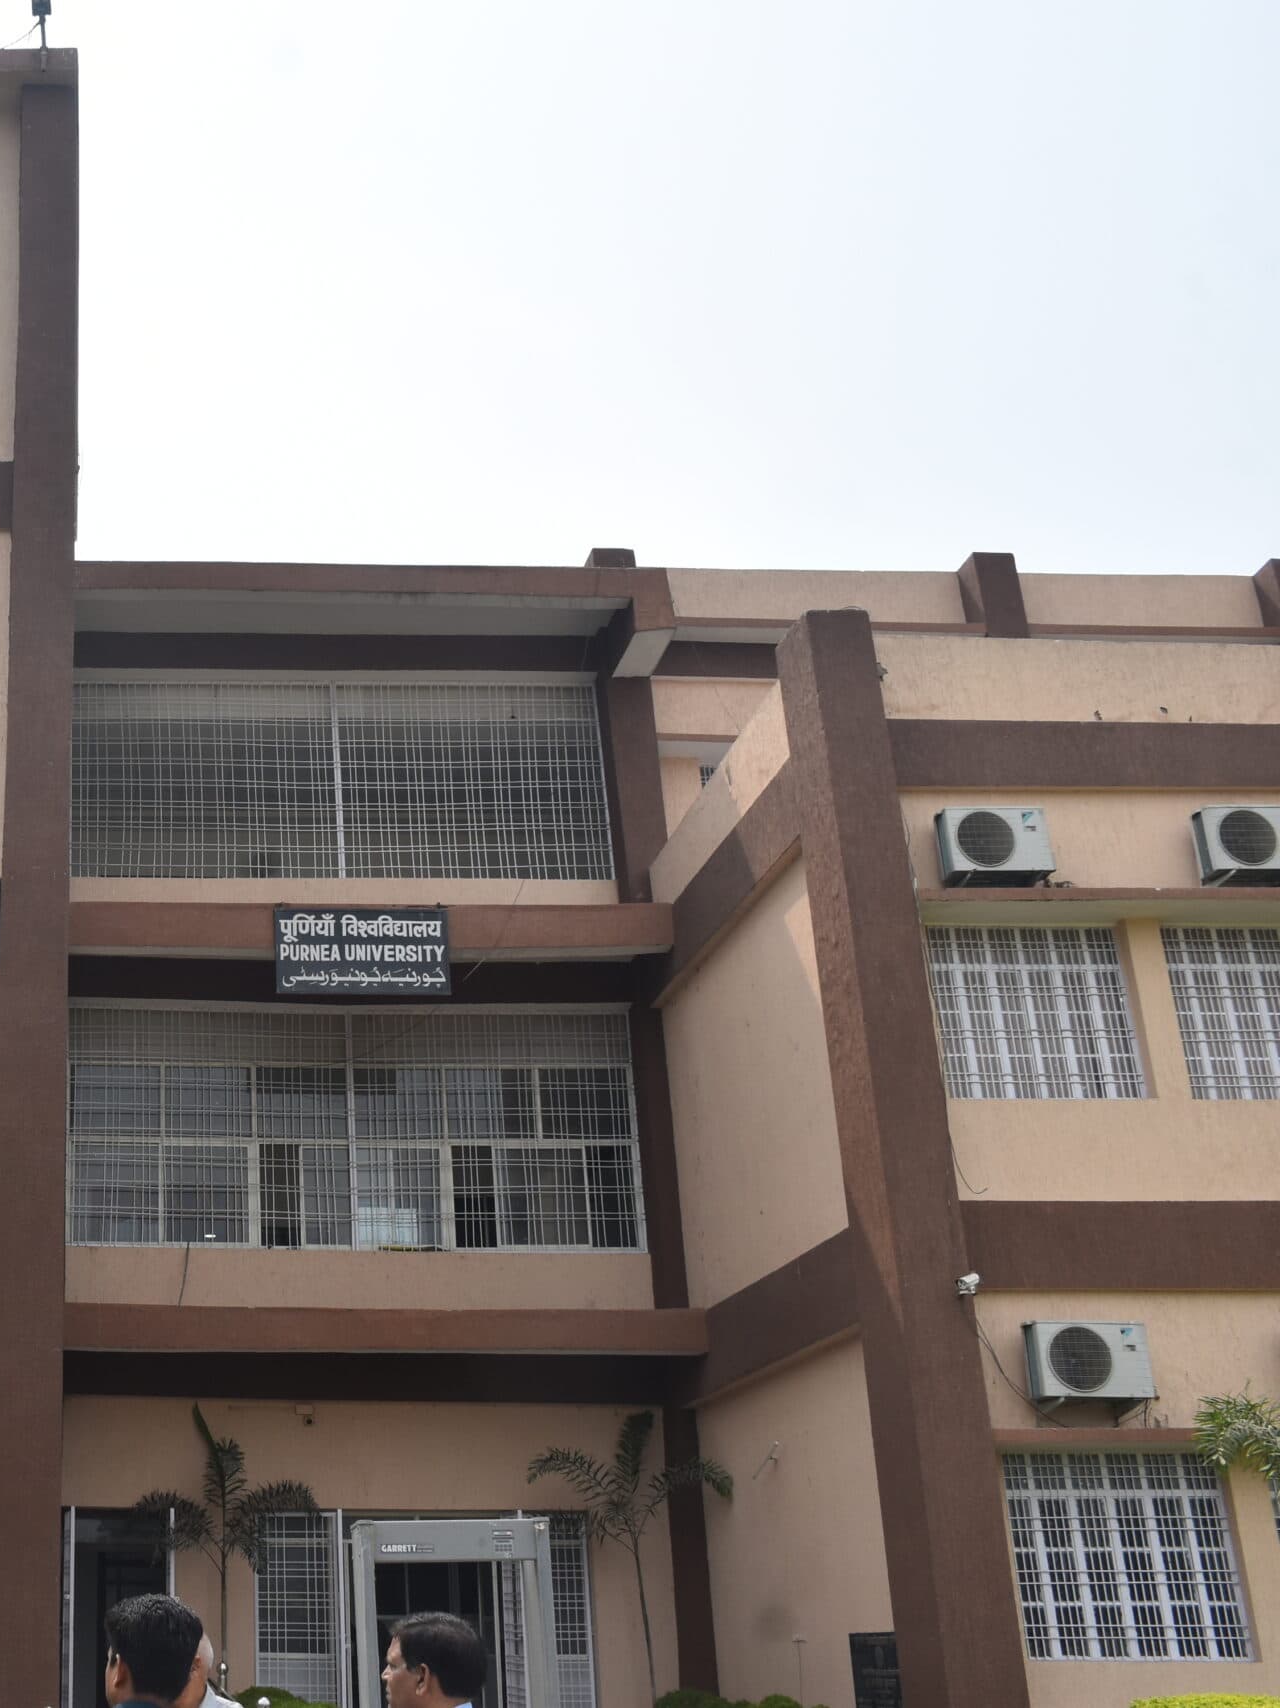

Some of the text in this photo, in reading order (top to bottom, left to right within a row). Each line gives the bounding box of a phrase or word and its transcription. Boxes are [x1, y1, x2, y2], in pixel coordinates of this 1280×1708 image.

[340, 914, 443, 938] विश्वविद्यालय
[279, 943, 446, 963] PURNEA UNIVERSITY
[381, 1544, 417, 1553] GARRETT
